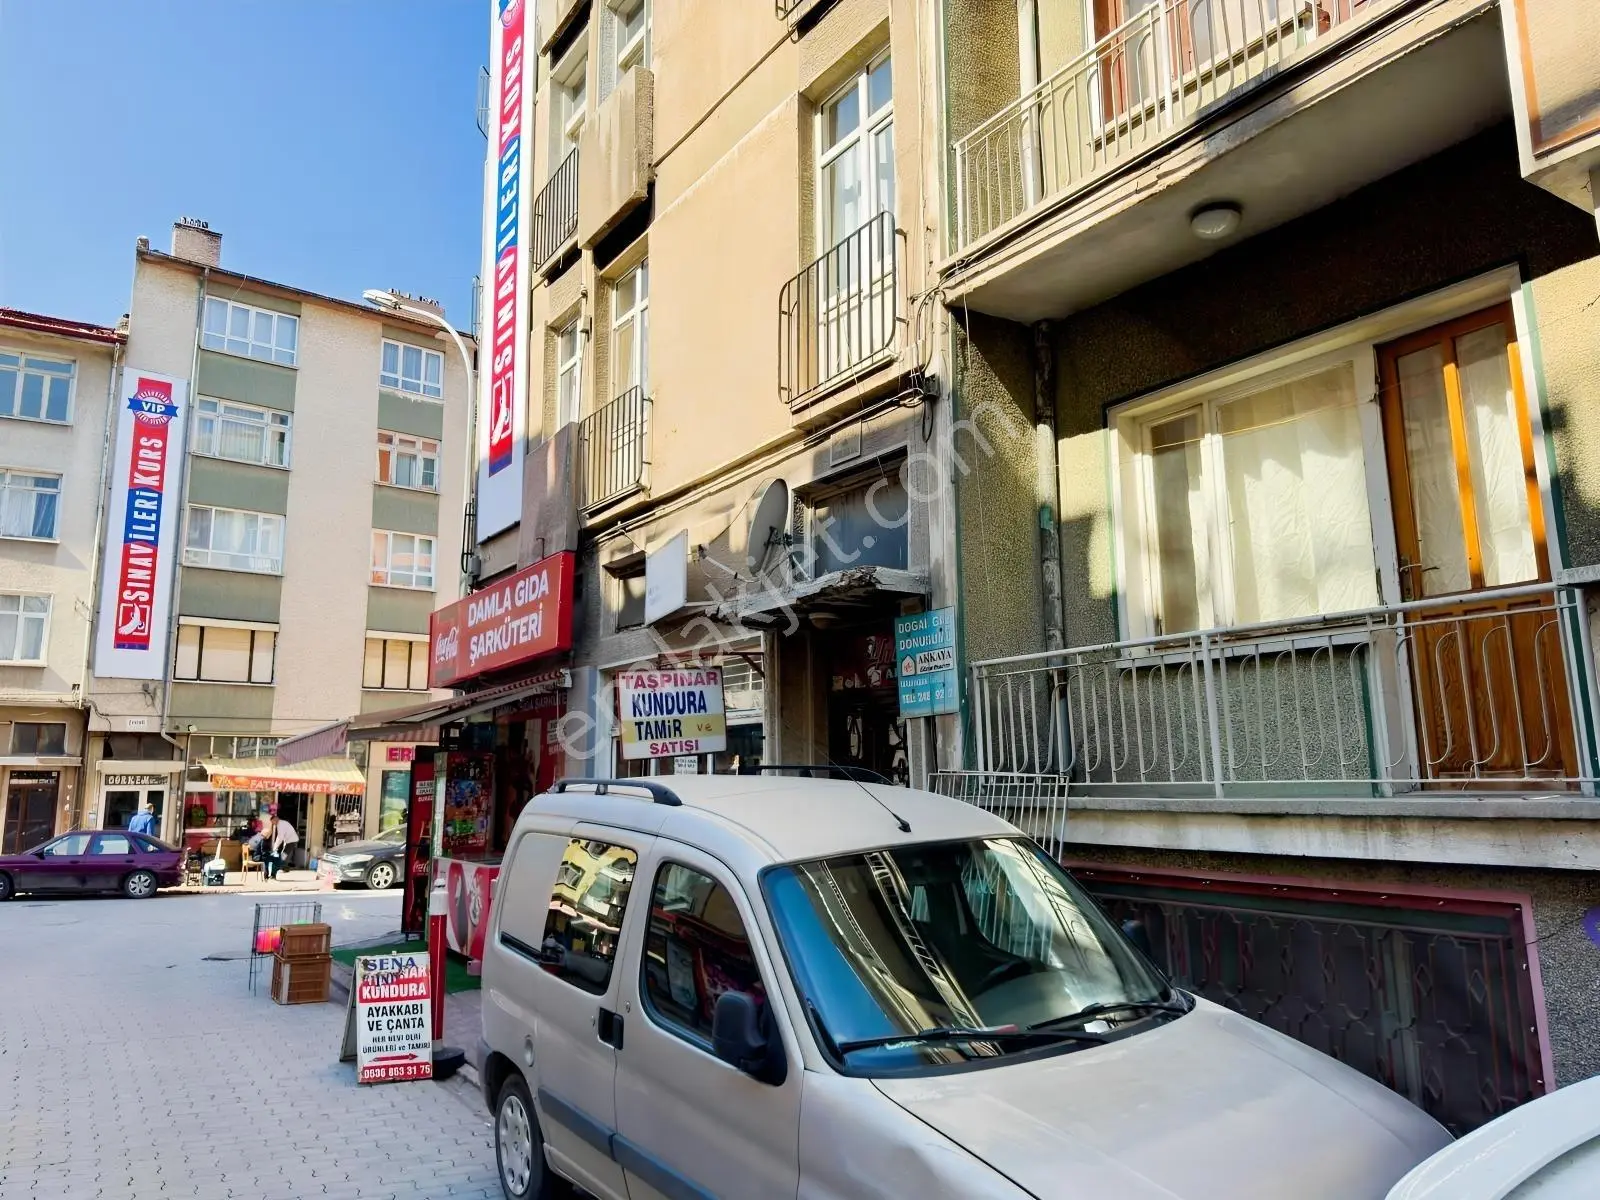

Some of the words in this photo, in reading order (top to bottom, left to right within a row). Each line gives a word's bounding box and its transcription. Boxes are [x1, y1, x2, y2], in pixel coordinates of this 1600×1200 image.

[501, 35, 522, 142] KURS
[494, 253, 515, 374] SINAV
[141, 401, 166, 413] VIP
[133, 436, 163, 486] KURS
[129, 490, 159, 541] İLERİ
[122, 543, 153, 602] SINAV
[467, 587, 512, 628] DAMLA
[514, 569, 549, 607] GIDA
[469, 602, 543, 667] ŞARKÜTERİ
[621, 671, 719, 692] TAŞPINAR
[632, 690, 708, 718] KUNDURA
[649, 739, 699, 755] SATIŞI
[367, 957, 417, 971] SENA
[362, 982, 427, 999] KUNDURA
[367, 1003, 423, 1018] AYAKKABI
[367, 1020, 382, 1031] VE
[387, 1017, 425, 1032] ÇANTA
[406, 1065, 418, 1075] 31
